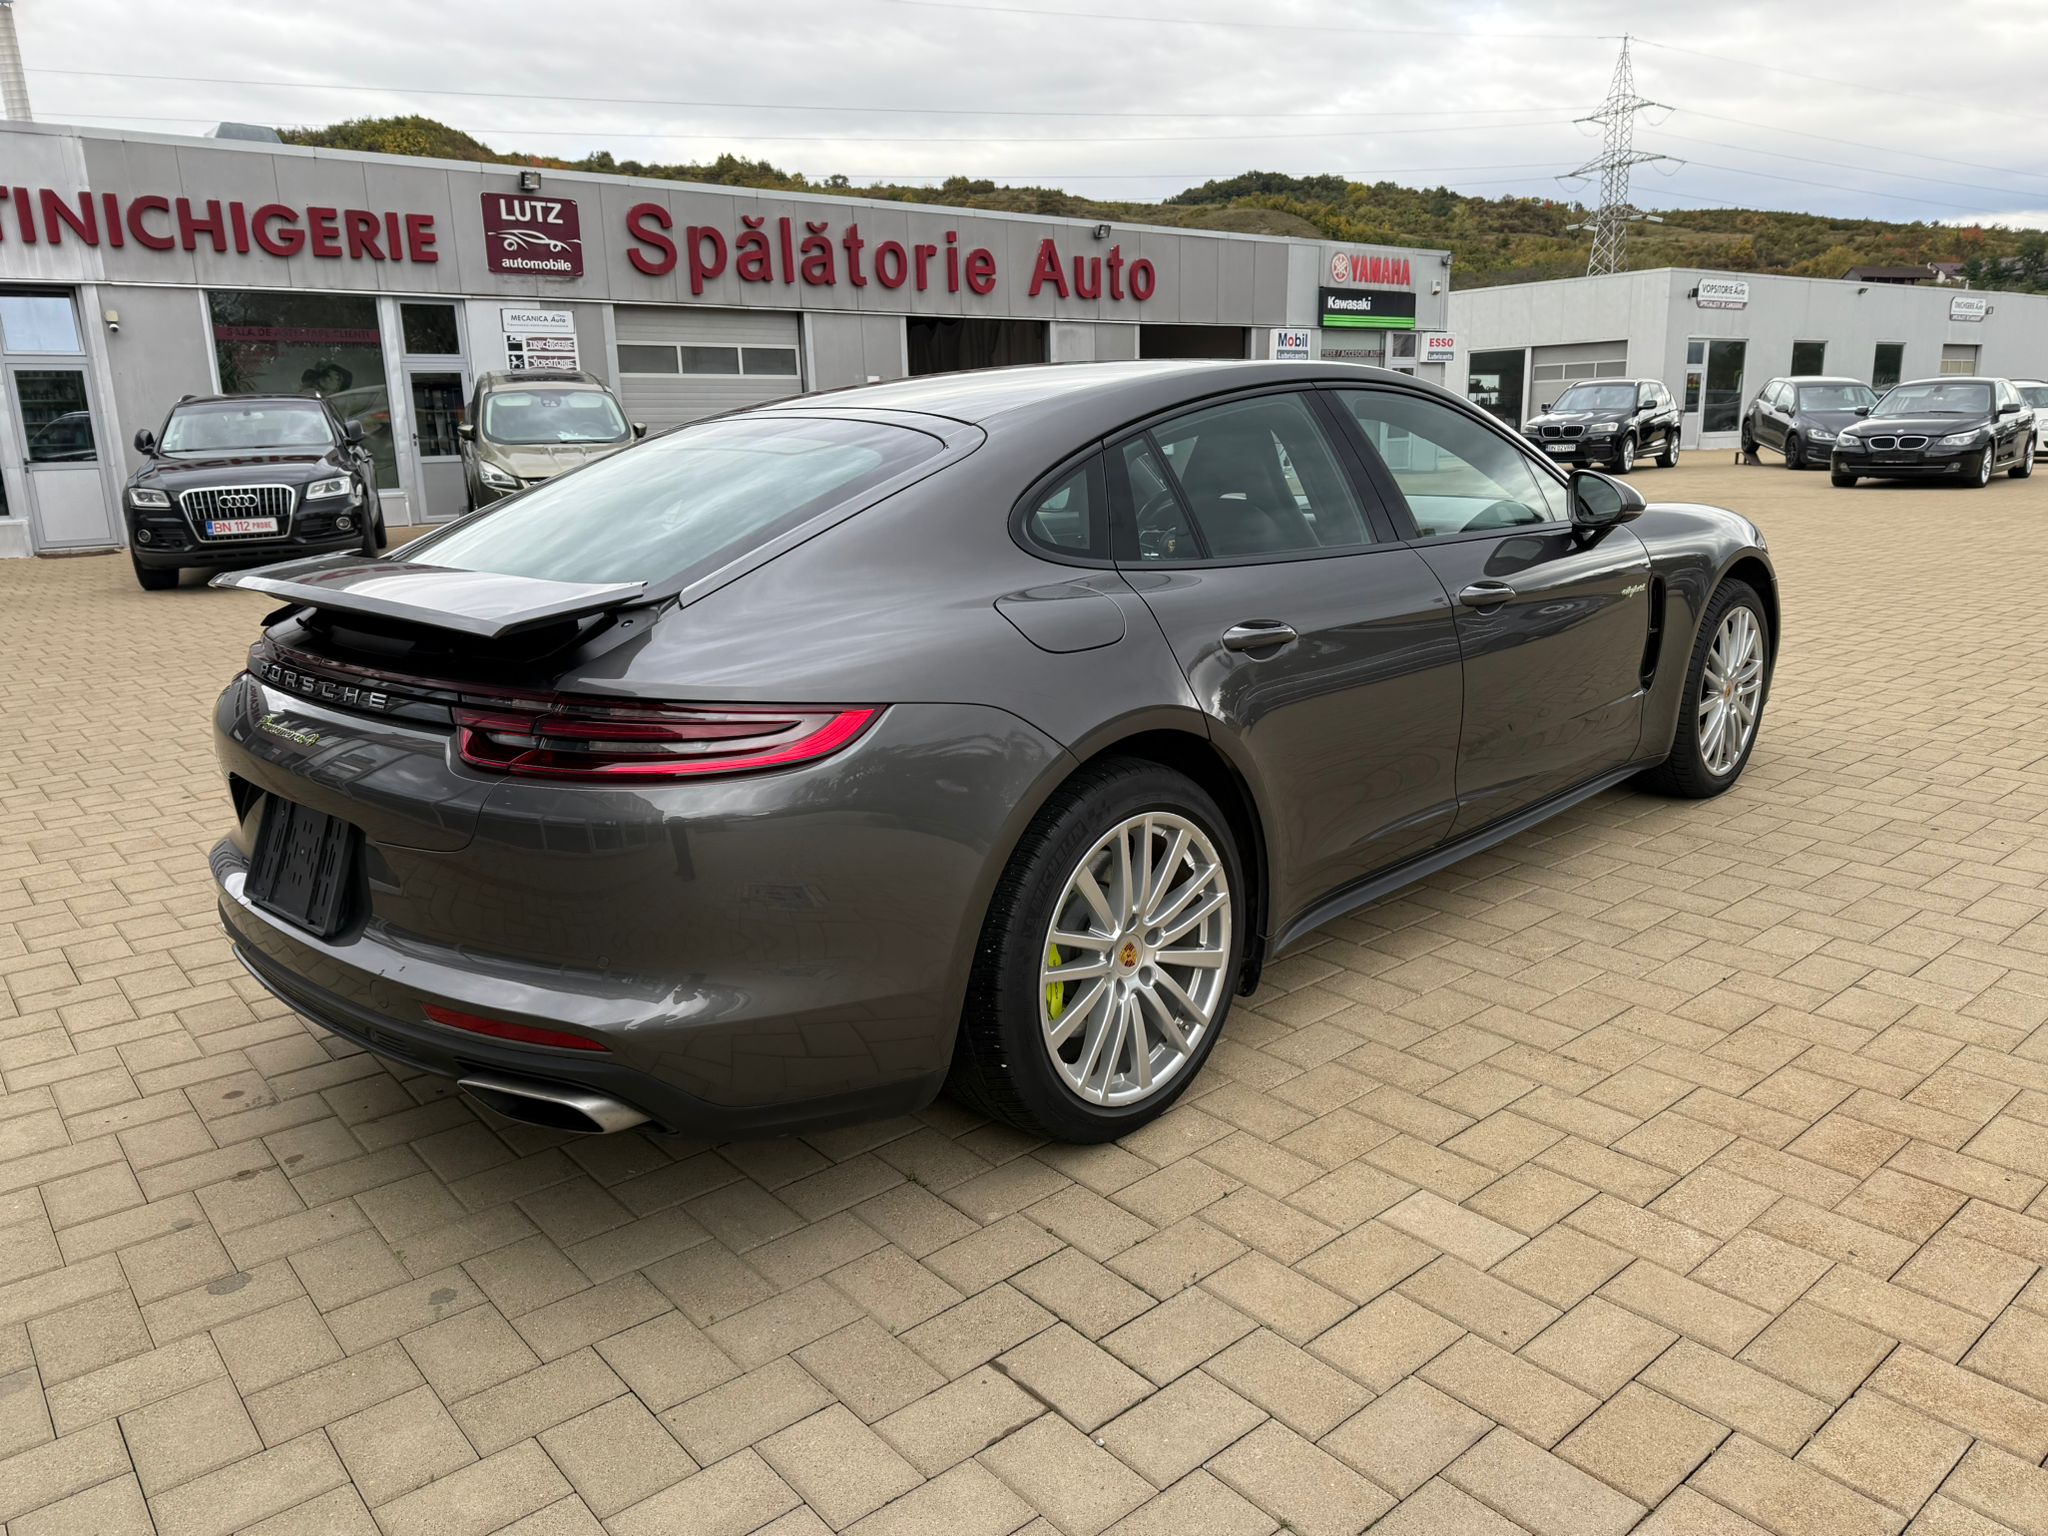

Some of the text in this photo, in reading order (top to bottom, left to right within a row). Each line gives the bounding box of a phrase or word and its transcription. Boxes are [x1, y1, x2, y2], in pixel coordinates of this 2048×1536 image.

[499, 199, 563, 224] LUTZ
[0, 186, 438, 263] INICHIGERIE
[626, 202, 1156, 300] Spălătorie Auto
[502, 258, 572, 271] automobile
[1350, 254, 1411, 286] YAMAHA
[1327, 296, 1371, 311] Kawasaki
[510, 314, 549, 322] MECANICA
[1278, 333, 1308, 347] Mobil
[1429, 338, 1454, 348] ESSO
[214, 521, 273, 533] BN 112 PROBE
[260, 662, 389, 709] PORSCHE
